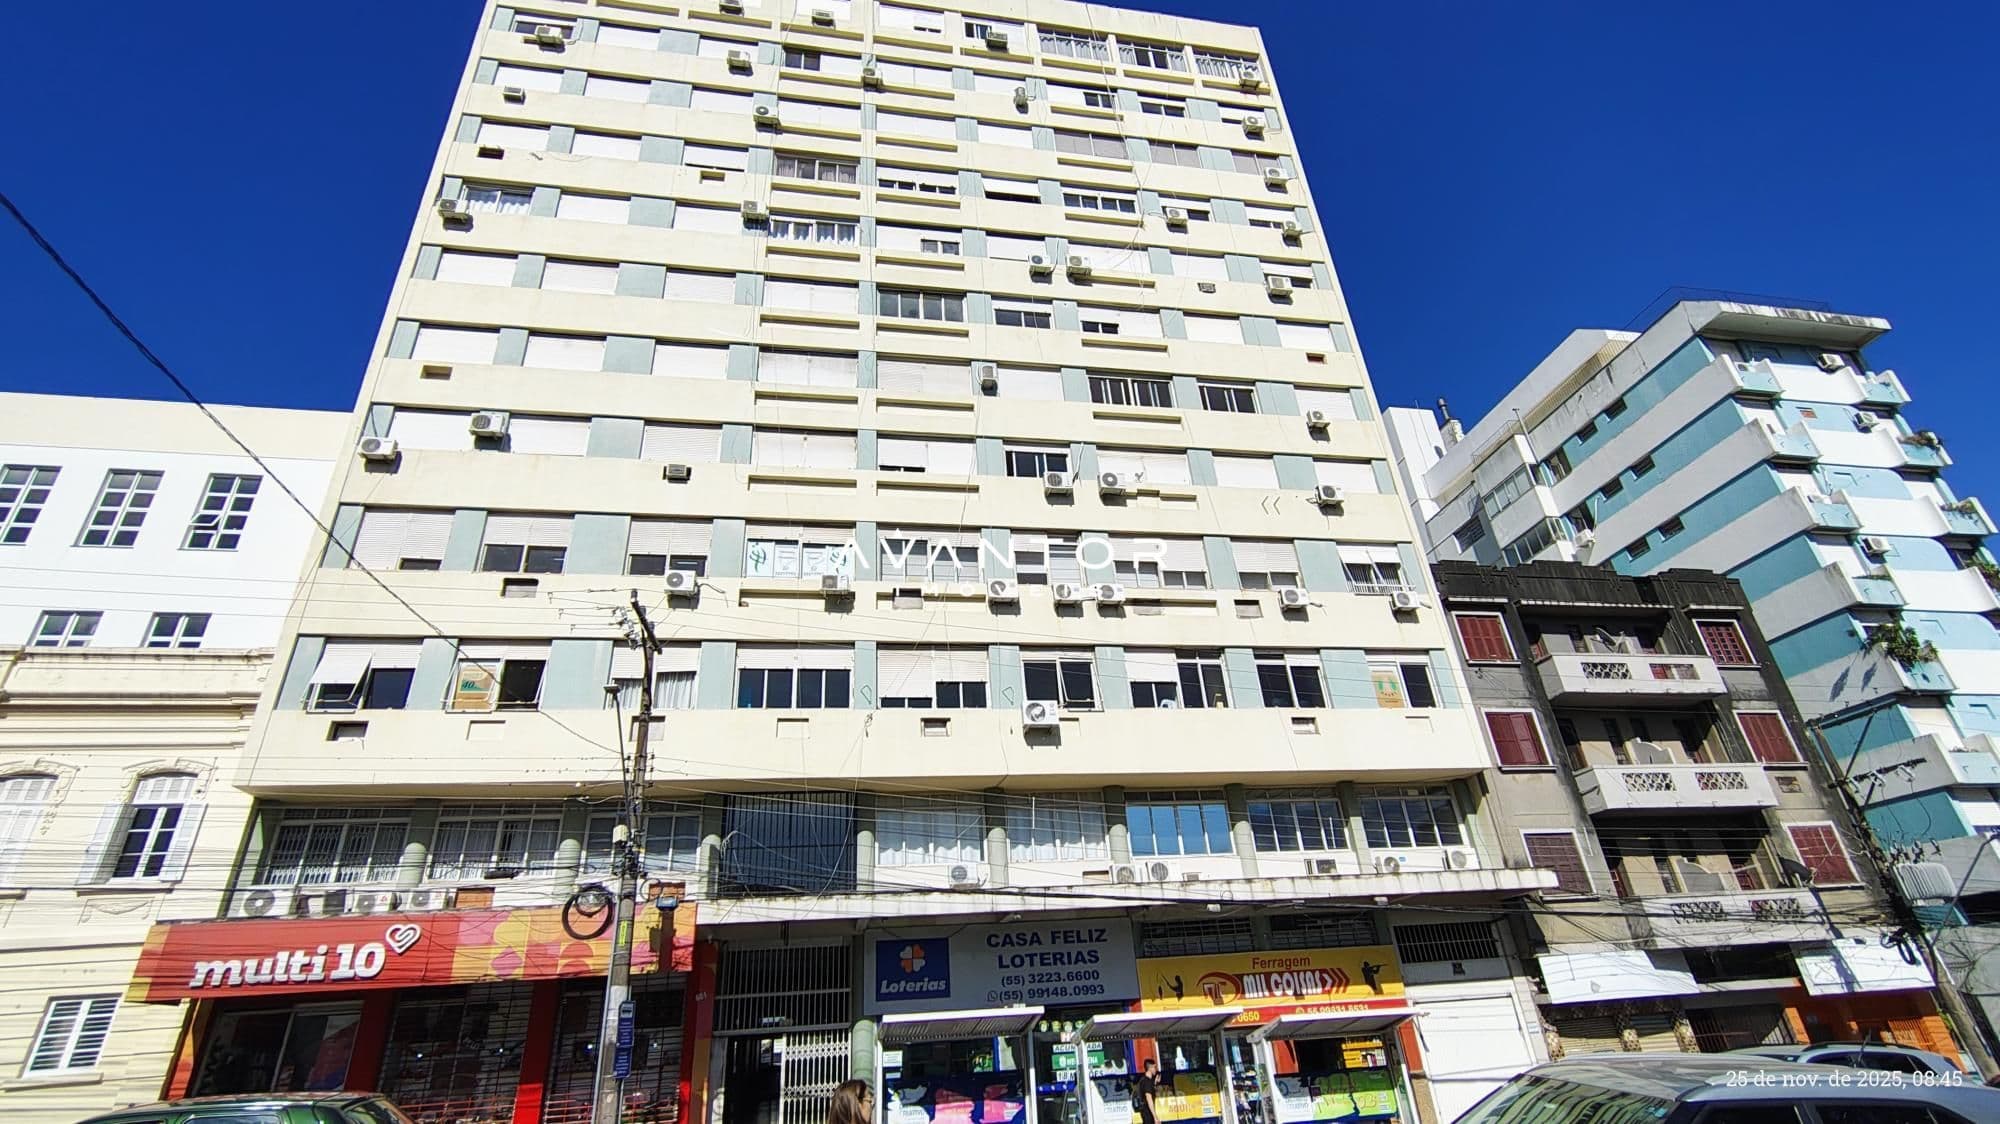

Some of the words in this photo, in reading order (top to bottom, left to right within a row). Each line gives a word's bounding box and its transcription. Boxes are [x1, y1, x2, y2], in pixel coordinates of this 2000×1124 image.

[986, 932, 1043, 948] CASA
[1051, 928, 1108, 945] FELIZ
[189, 944, 328, 988] multi
[331, 942, 386, 980] 10
[998, 949, 1100, 969] LOTERIAS
[1252, 957, 1311, 970] Ferragem
[880, 977, 946, 994] Loterias
[1001, 975, 1025, 988] (55)
[1028, 970, 1100, 984] 3223.6600
[1242, 973, 1269, 999] MIL
[999, 990, 1023, 1002] (55)
[1028, 985, 1105, 999] 99148.0993
